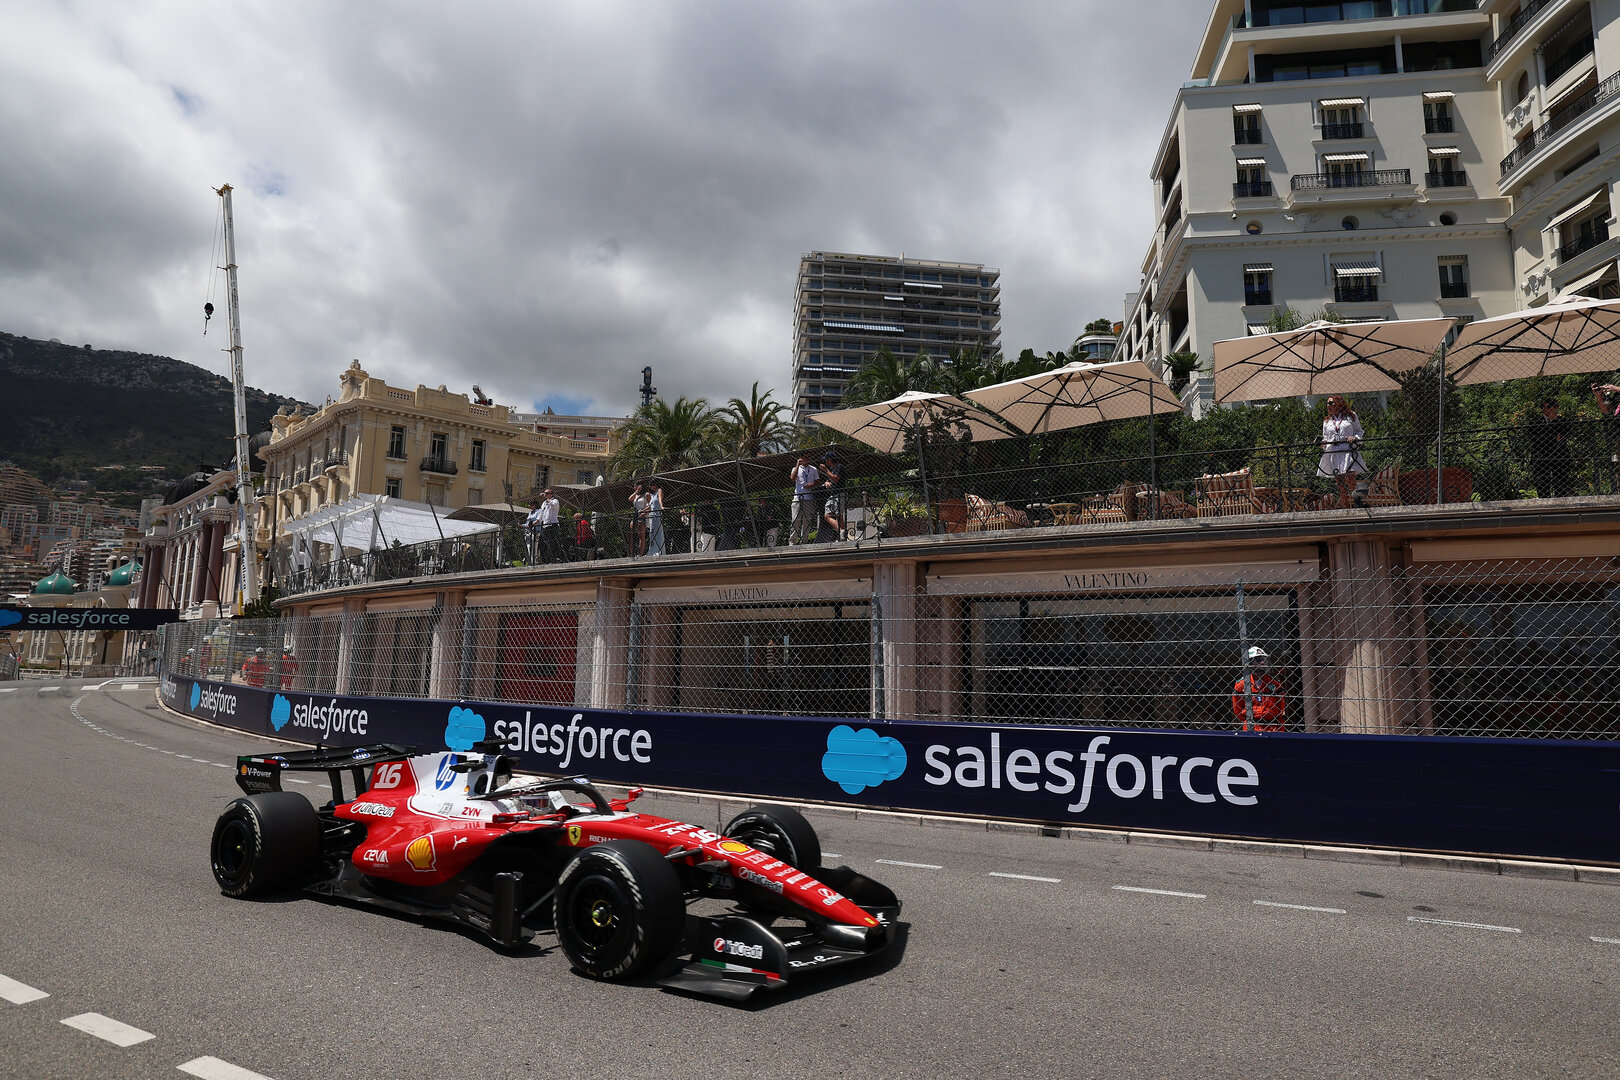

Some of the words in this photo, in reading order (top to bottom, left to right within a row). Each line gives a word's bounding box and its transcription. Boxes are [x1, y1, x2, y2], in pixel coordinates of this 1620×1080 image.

[1064, 571, 1148, 589] VALENTINO
[718, 587, 769, 600] VALENTINO
[28, 610, 130, 628] salesforce
[200, 685, 237, 718] salesforce
[293, 698, 368, 740] salesforce
[494, 711, 652, 769] salesforce
[247, 767, 272, 778] V-Power
[374, 763, 403, 789] 16
[437, 753, 456, 791] hp
[924, 732, 1260, 814] salesforce
[462, 807, 481, 817] ZYN
[688, 829, 721, 844] 16
[724, 940, 763, 960] UniCredit
